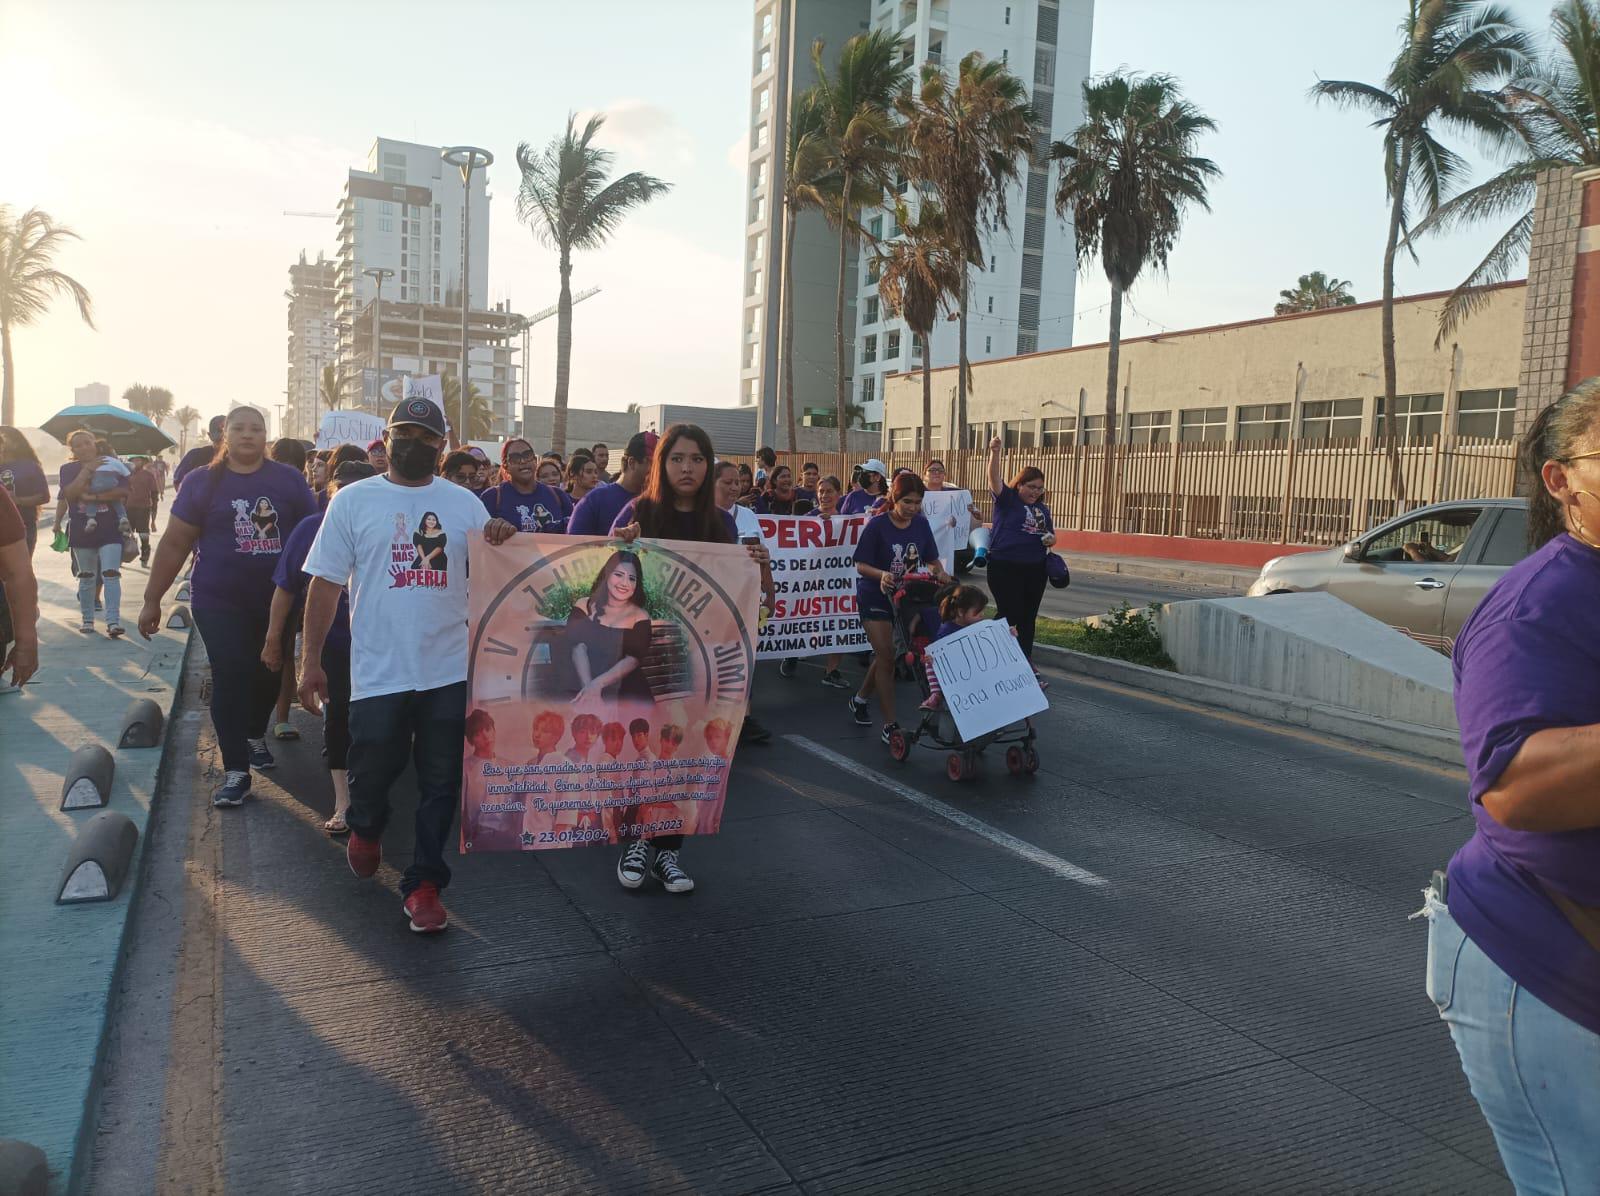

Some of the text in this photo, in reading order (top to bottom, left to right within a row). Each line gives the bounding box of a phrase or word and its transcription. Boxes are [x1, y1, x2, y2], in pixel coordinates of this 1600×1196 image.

[950, 494, 966, 516] NO
[392, 551, 414, 563] MÁS
[790, 559, 808, 571] DE
[809, 558, 822, 570] LA
[406, 570, 448, 587] PERLA
[791, 581, 800, 593] A
[803, 579, 824, 593] DAR
[827, 577, 852, 590] CON
[659, 562, 714, 620] SUGA
[778, 621, 820, 636] JUECES
[822, 619, 835, 631] LE
[756, 633, 867, 652] MÁXIMA QUE MERE
[483, 762, 502, 776] Los
[505, 765, 522, 781] que
[523, 763, 543, 775] son
[543, 761, 581, 775] amados
[581, 763, 595, 774] no
[487, 780, 550, 795] inmortalidad.
[549, 799, 593, 816] queremos
[539, 819, 683, 843] 23.01.2004 18.06.2023
